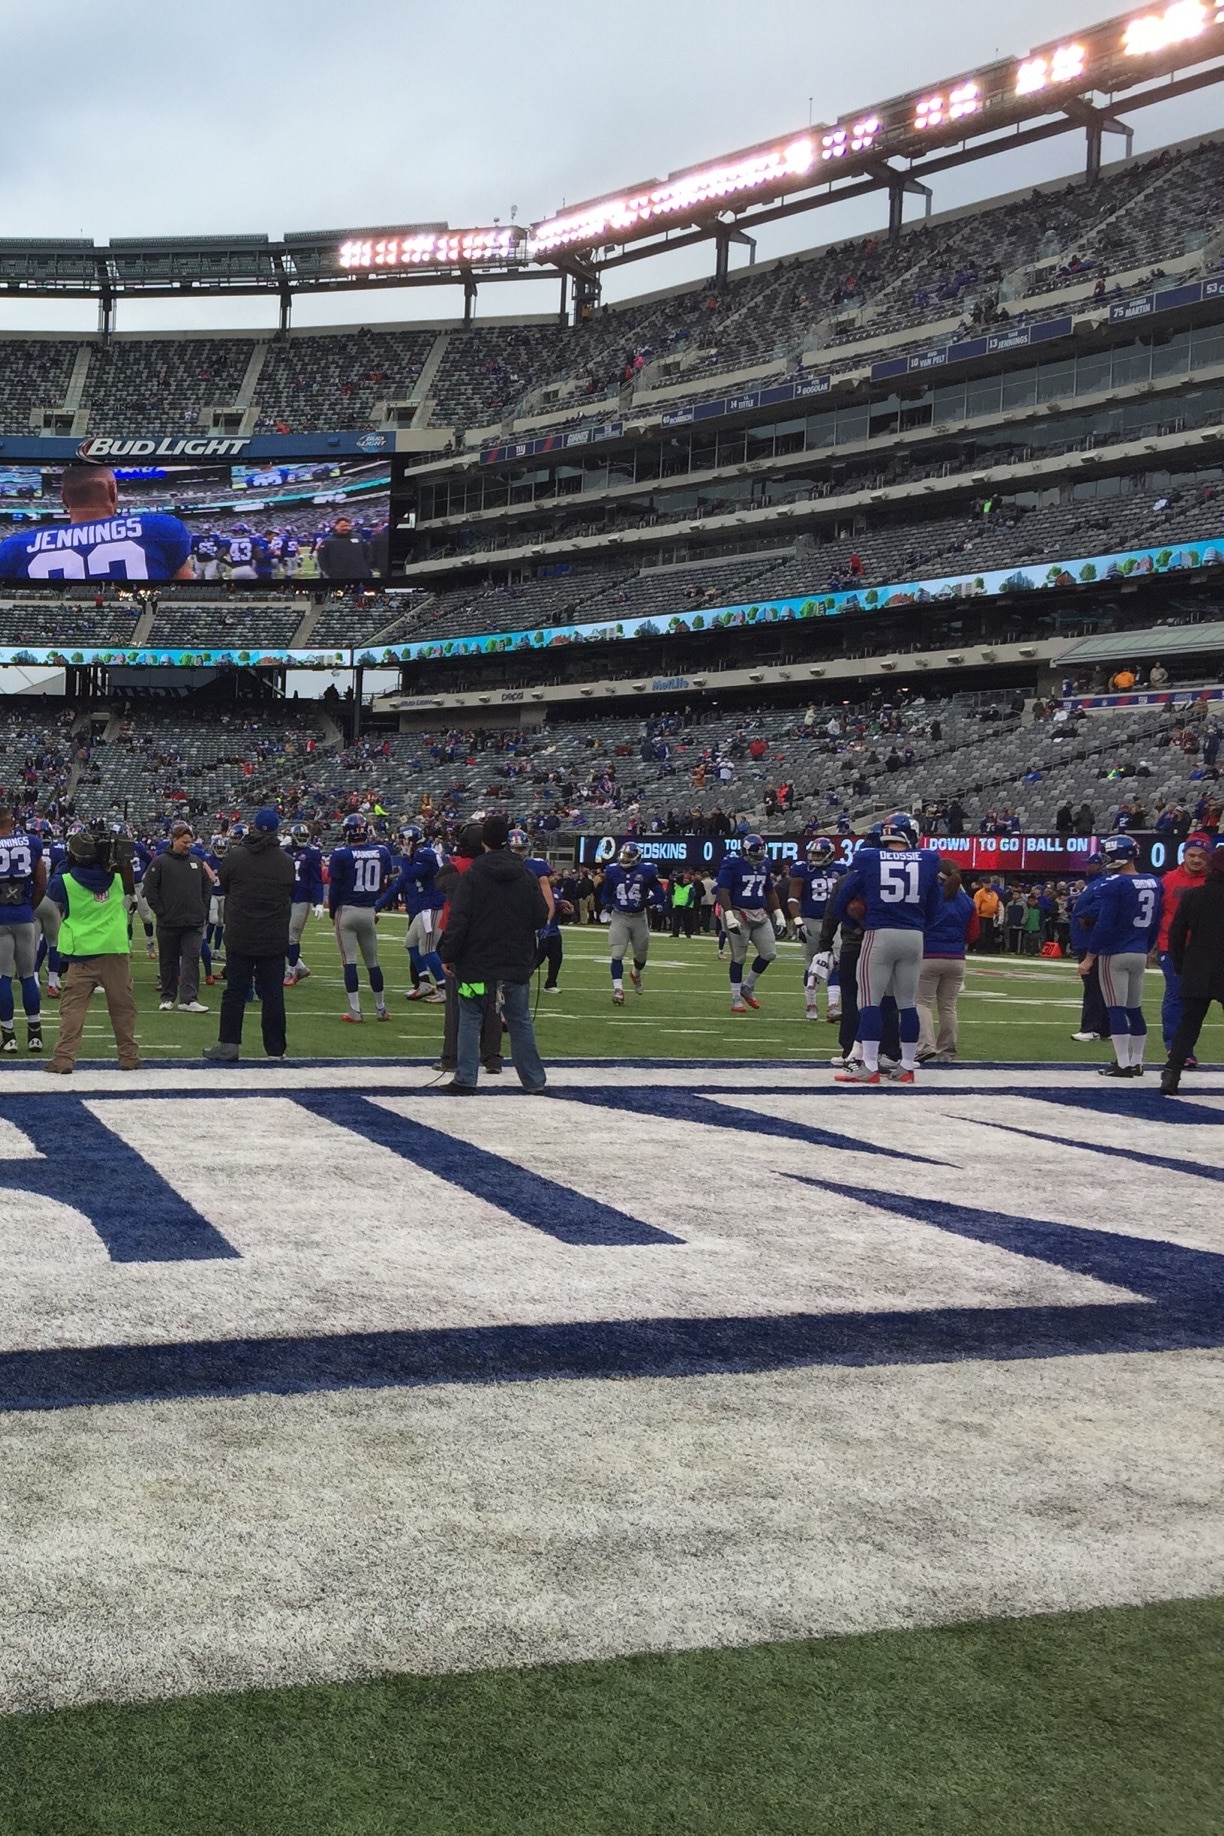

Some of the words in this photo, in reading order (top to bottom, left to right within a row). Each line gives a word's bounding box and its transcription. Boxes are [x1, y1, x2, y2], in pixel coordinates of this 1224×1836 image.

[1206, 282, 1218, 294] 53
[1114, 307, 1124, 318] 75
[1125, 304, 1151, 318] MARTIN
[989, 339, 998, 349] 13
[998, 335, 1028, 349] JENNINGS
[932, 354, 946, 365] PELT
[802, 382, 829, 396] GOGOLAK
[87, 437, 160, 455] BUD
[155, 437, 251, 455] LIGHT
[356, 438, 387, 447] LIGHT
[26, 517, 142, 553] JENNINGS
[229, 542, 252, 562] 43
[651, 677, 689, 690] MetLife
[501, 691, 524, 702] pepsi
[703, 841, 713, 861] 0
[929, 838, 970, 851] DOWN
[979, 838, 996, 851] TO
[1000, 838, 1019, 851] GO
[1027, 838, 1064, 852] BALL
[1066, 838, 1088, 852] ON
[880, 851, 922, 861] DEOSSIE
[1151, 842, 1165, 868] 0
[353, 859, 381, 892] 10
[880, 861, 920, 903] 51
[742, 875, 766, 897] 77
[616, 882, 641, 906] 44
[1133, 889, 1156, 928] 3
